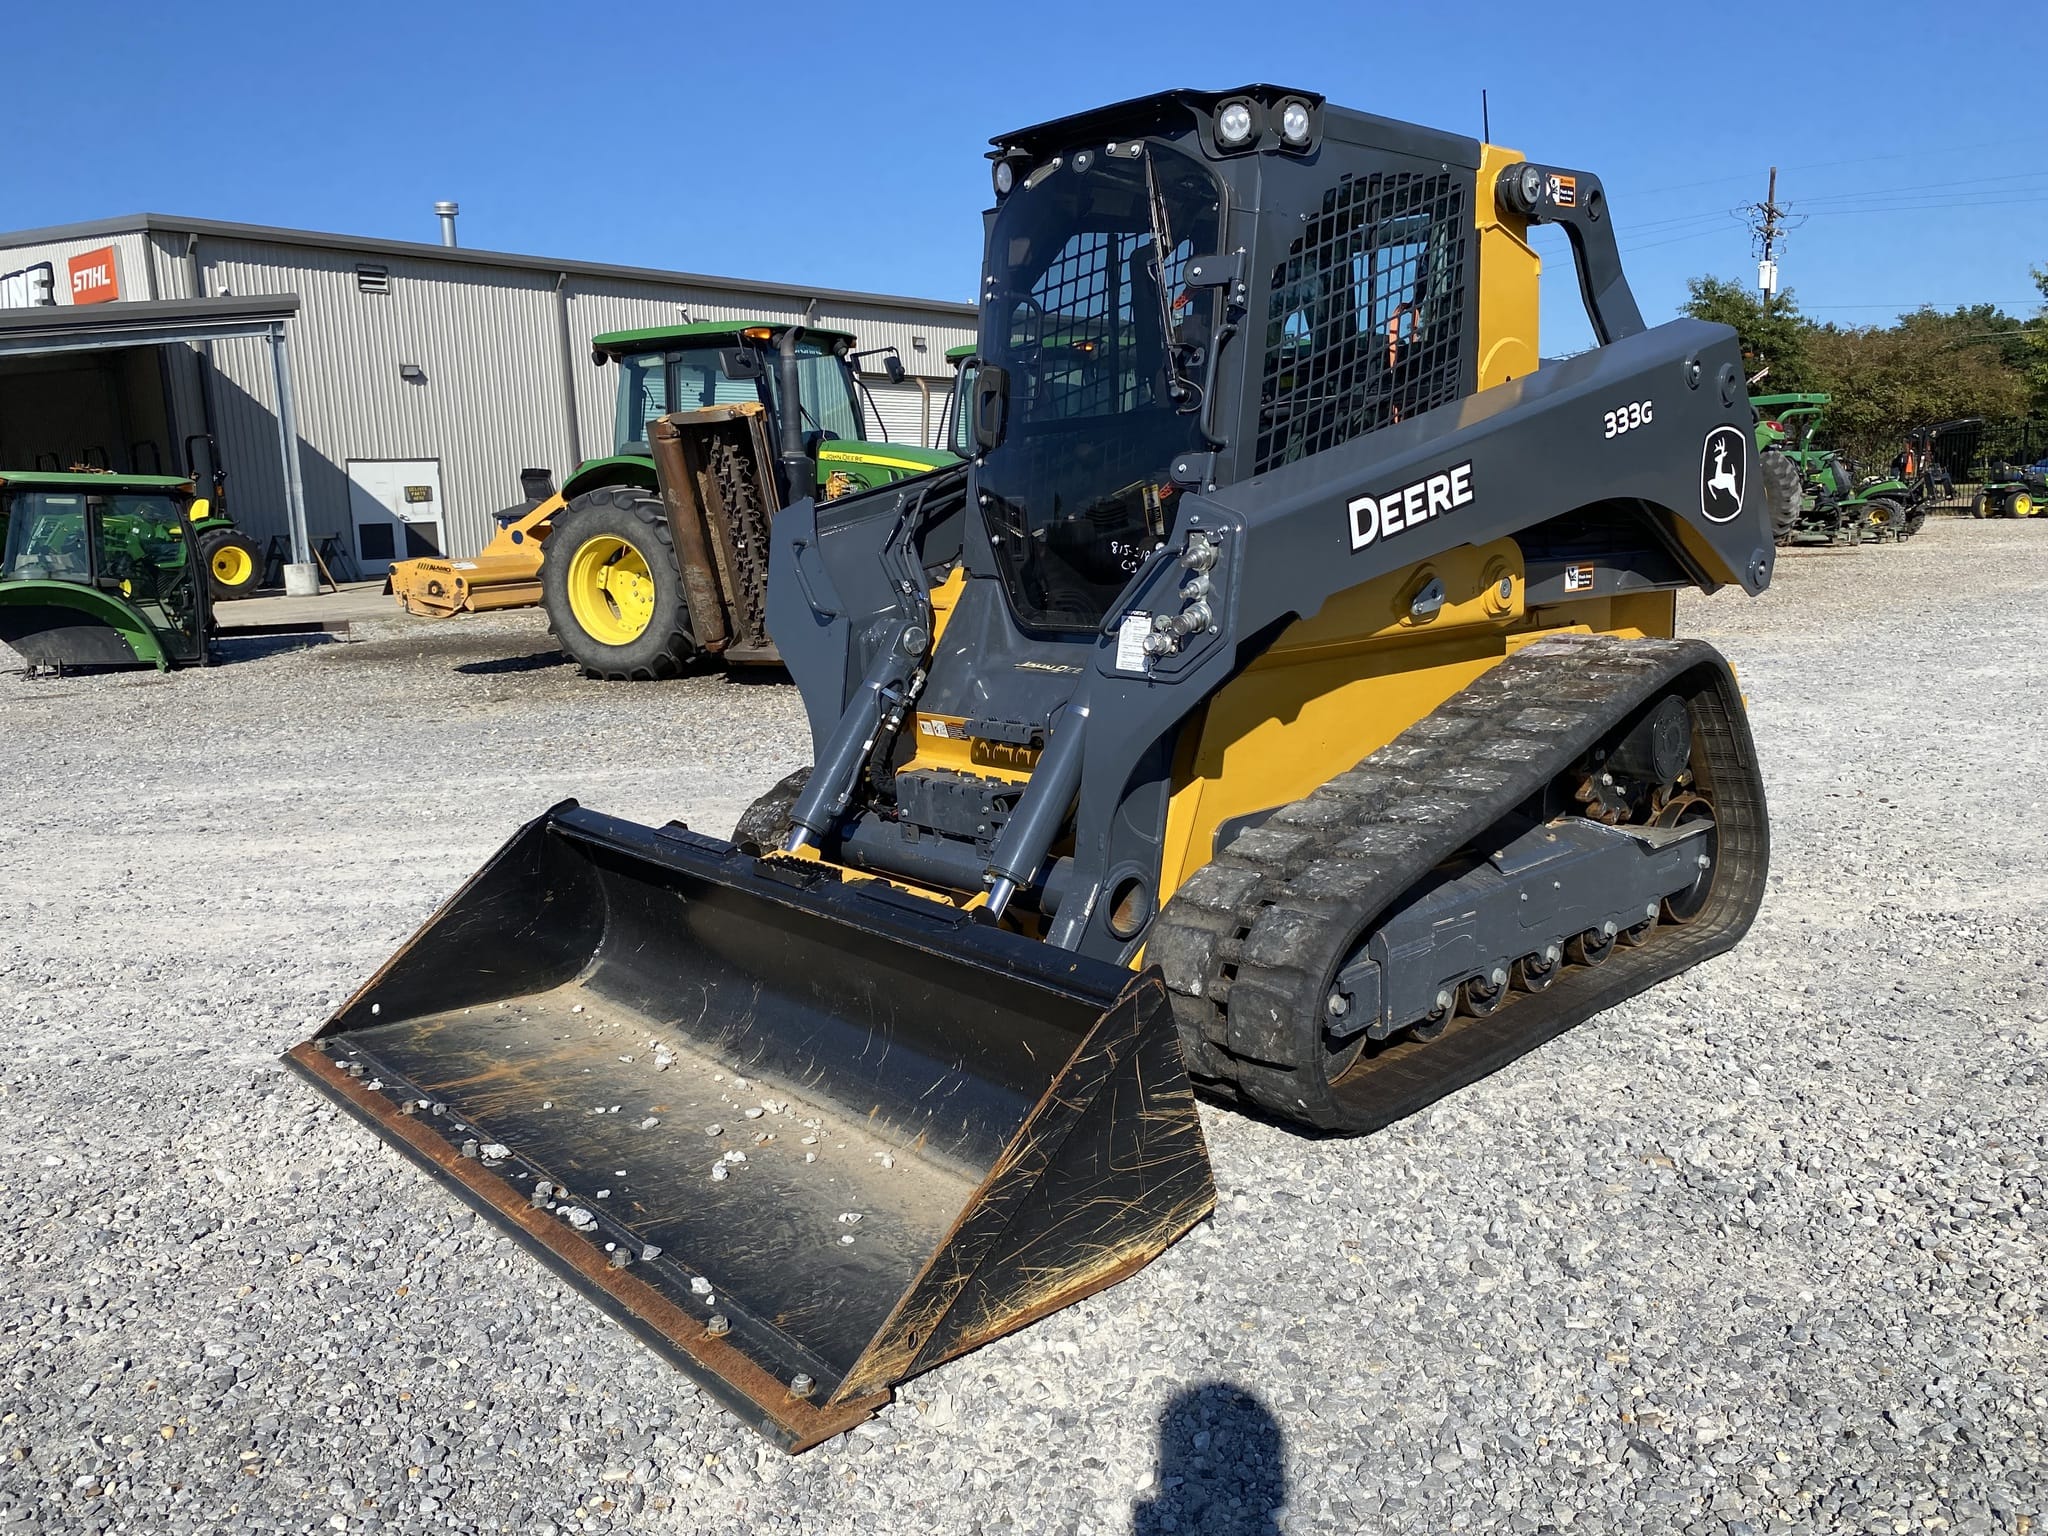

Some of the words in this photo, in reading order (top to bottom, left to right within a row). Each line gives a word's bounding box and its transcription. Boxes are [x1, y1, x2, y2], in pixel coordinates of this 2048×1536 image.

[73, 264, 111, 293] STIHL
[1604, 400, 1653, 439] 333G
[842, 454, 864, 462] DEERE
[1348, 463, 1473, 550] DEERE
